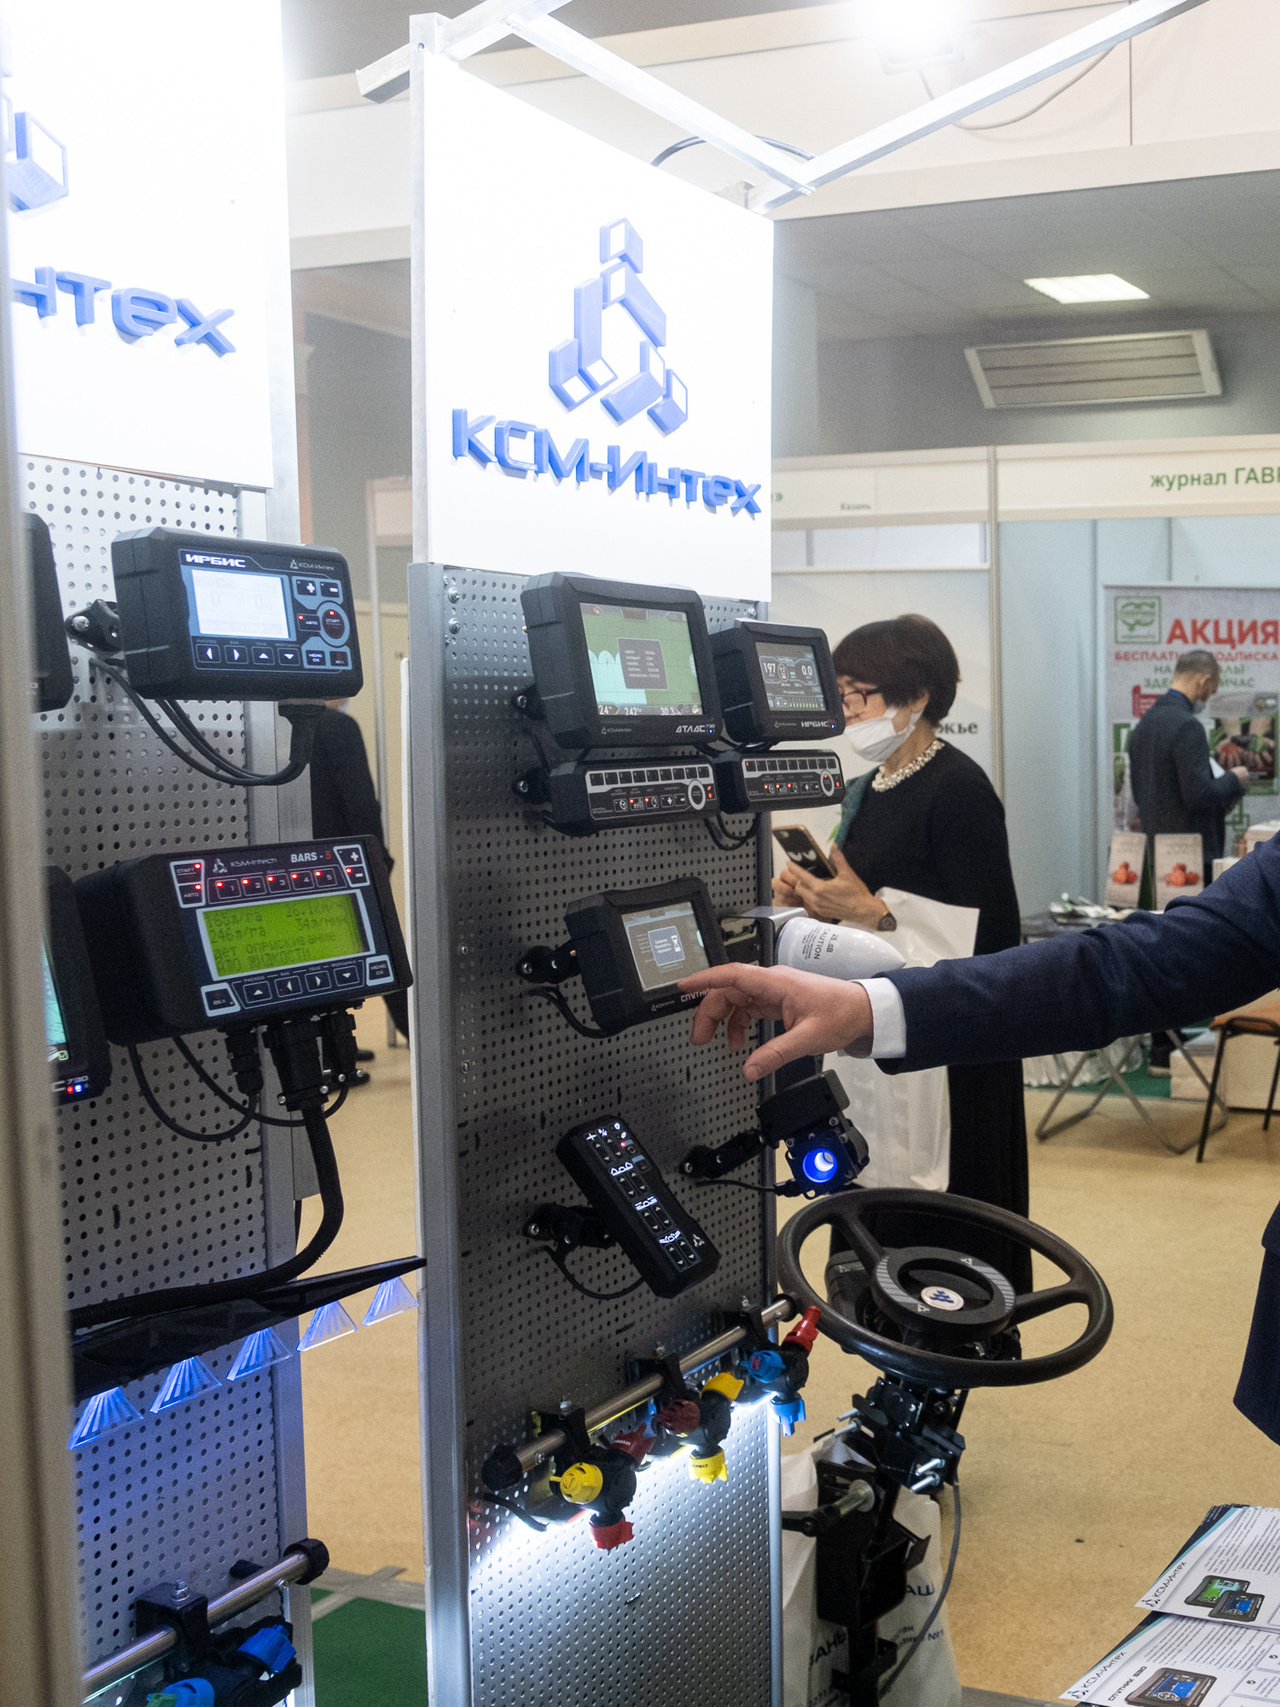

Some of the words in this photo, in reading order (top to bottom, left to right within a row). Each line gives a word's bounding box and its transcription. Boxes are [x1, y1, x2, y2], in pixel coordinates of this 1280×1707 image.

[1150, 472, 1227, 491] журнал
[184, 553, 247, 569] ИРБИС
[1166, 618, 1280, 649] АКЦИЯ
[290, 852, 318, 863] BARS
[814, 927, 832, 960] CAUTION
